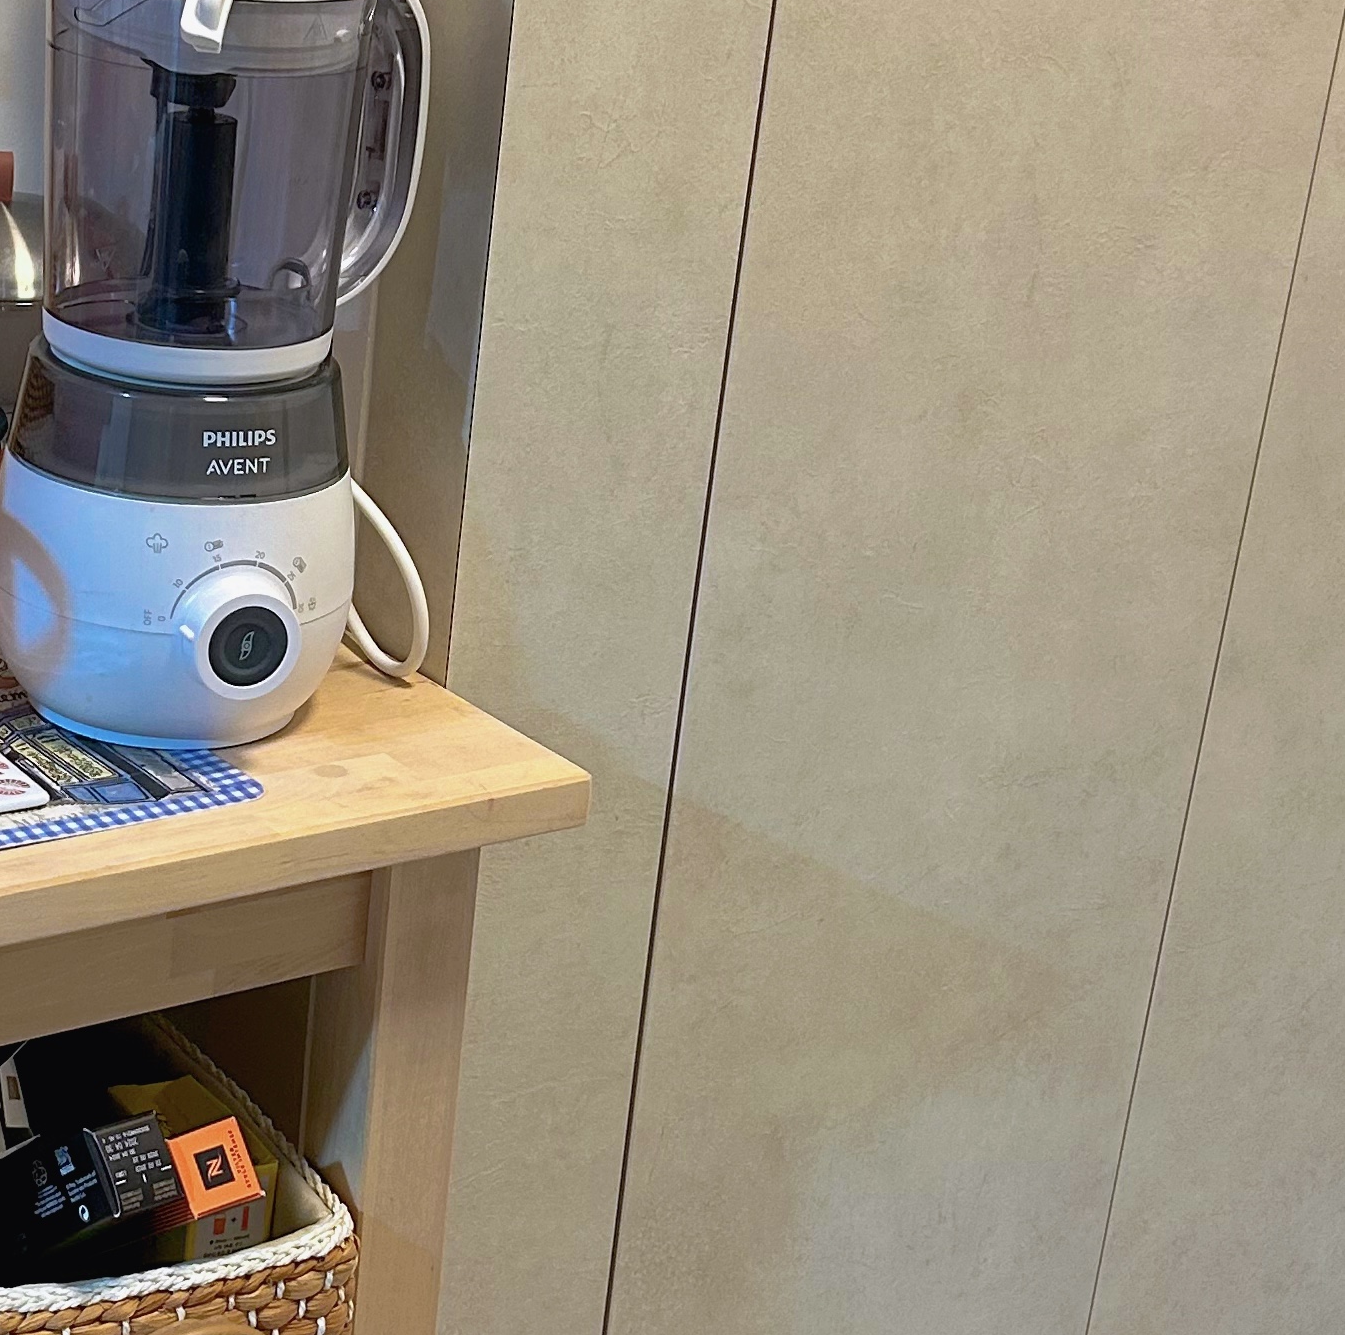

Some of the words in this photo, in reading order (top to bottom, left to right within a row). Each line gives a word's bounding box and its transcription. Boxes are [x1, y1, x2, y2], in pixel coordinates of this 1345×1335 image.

[202, 429, 276, 448] PHILIPS
[206, 457, 271, 476] AVENT
[143, 609, 153, 626] OFF
